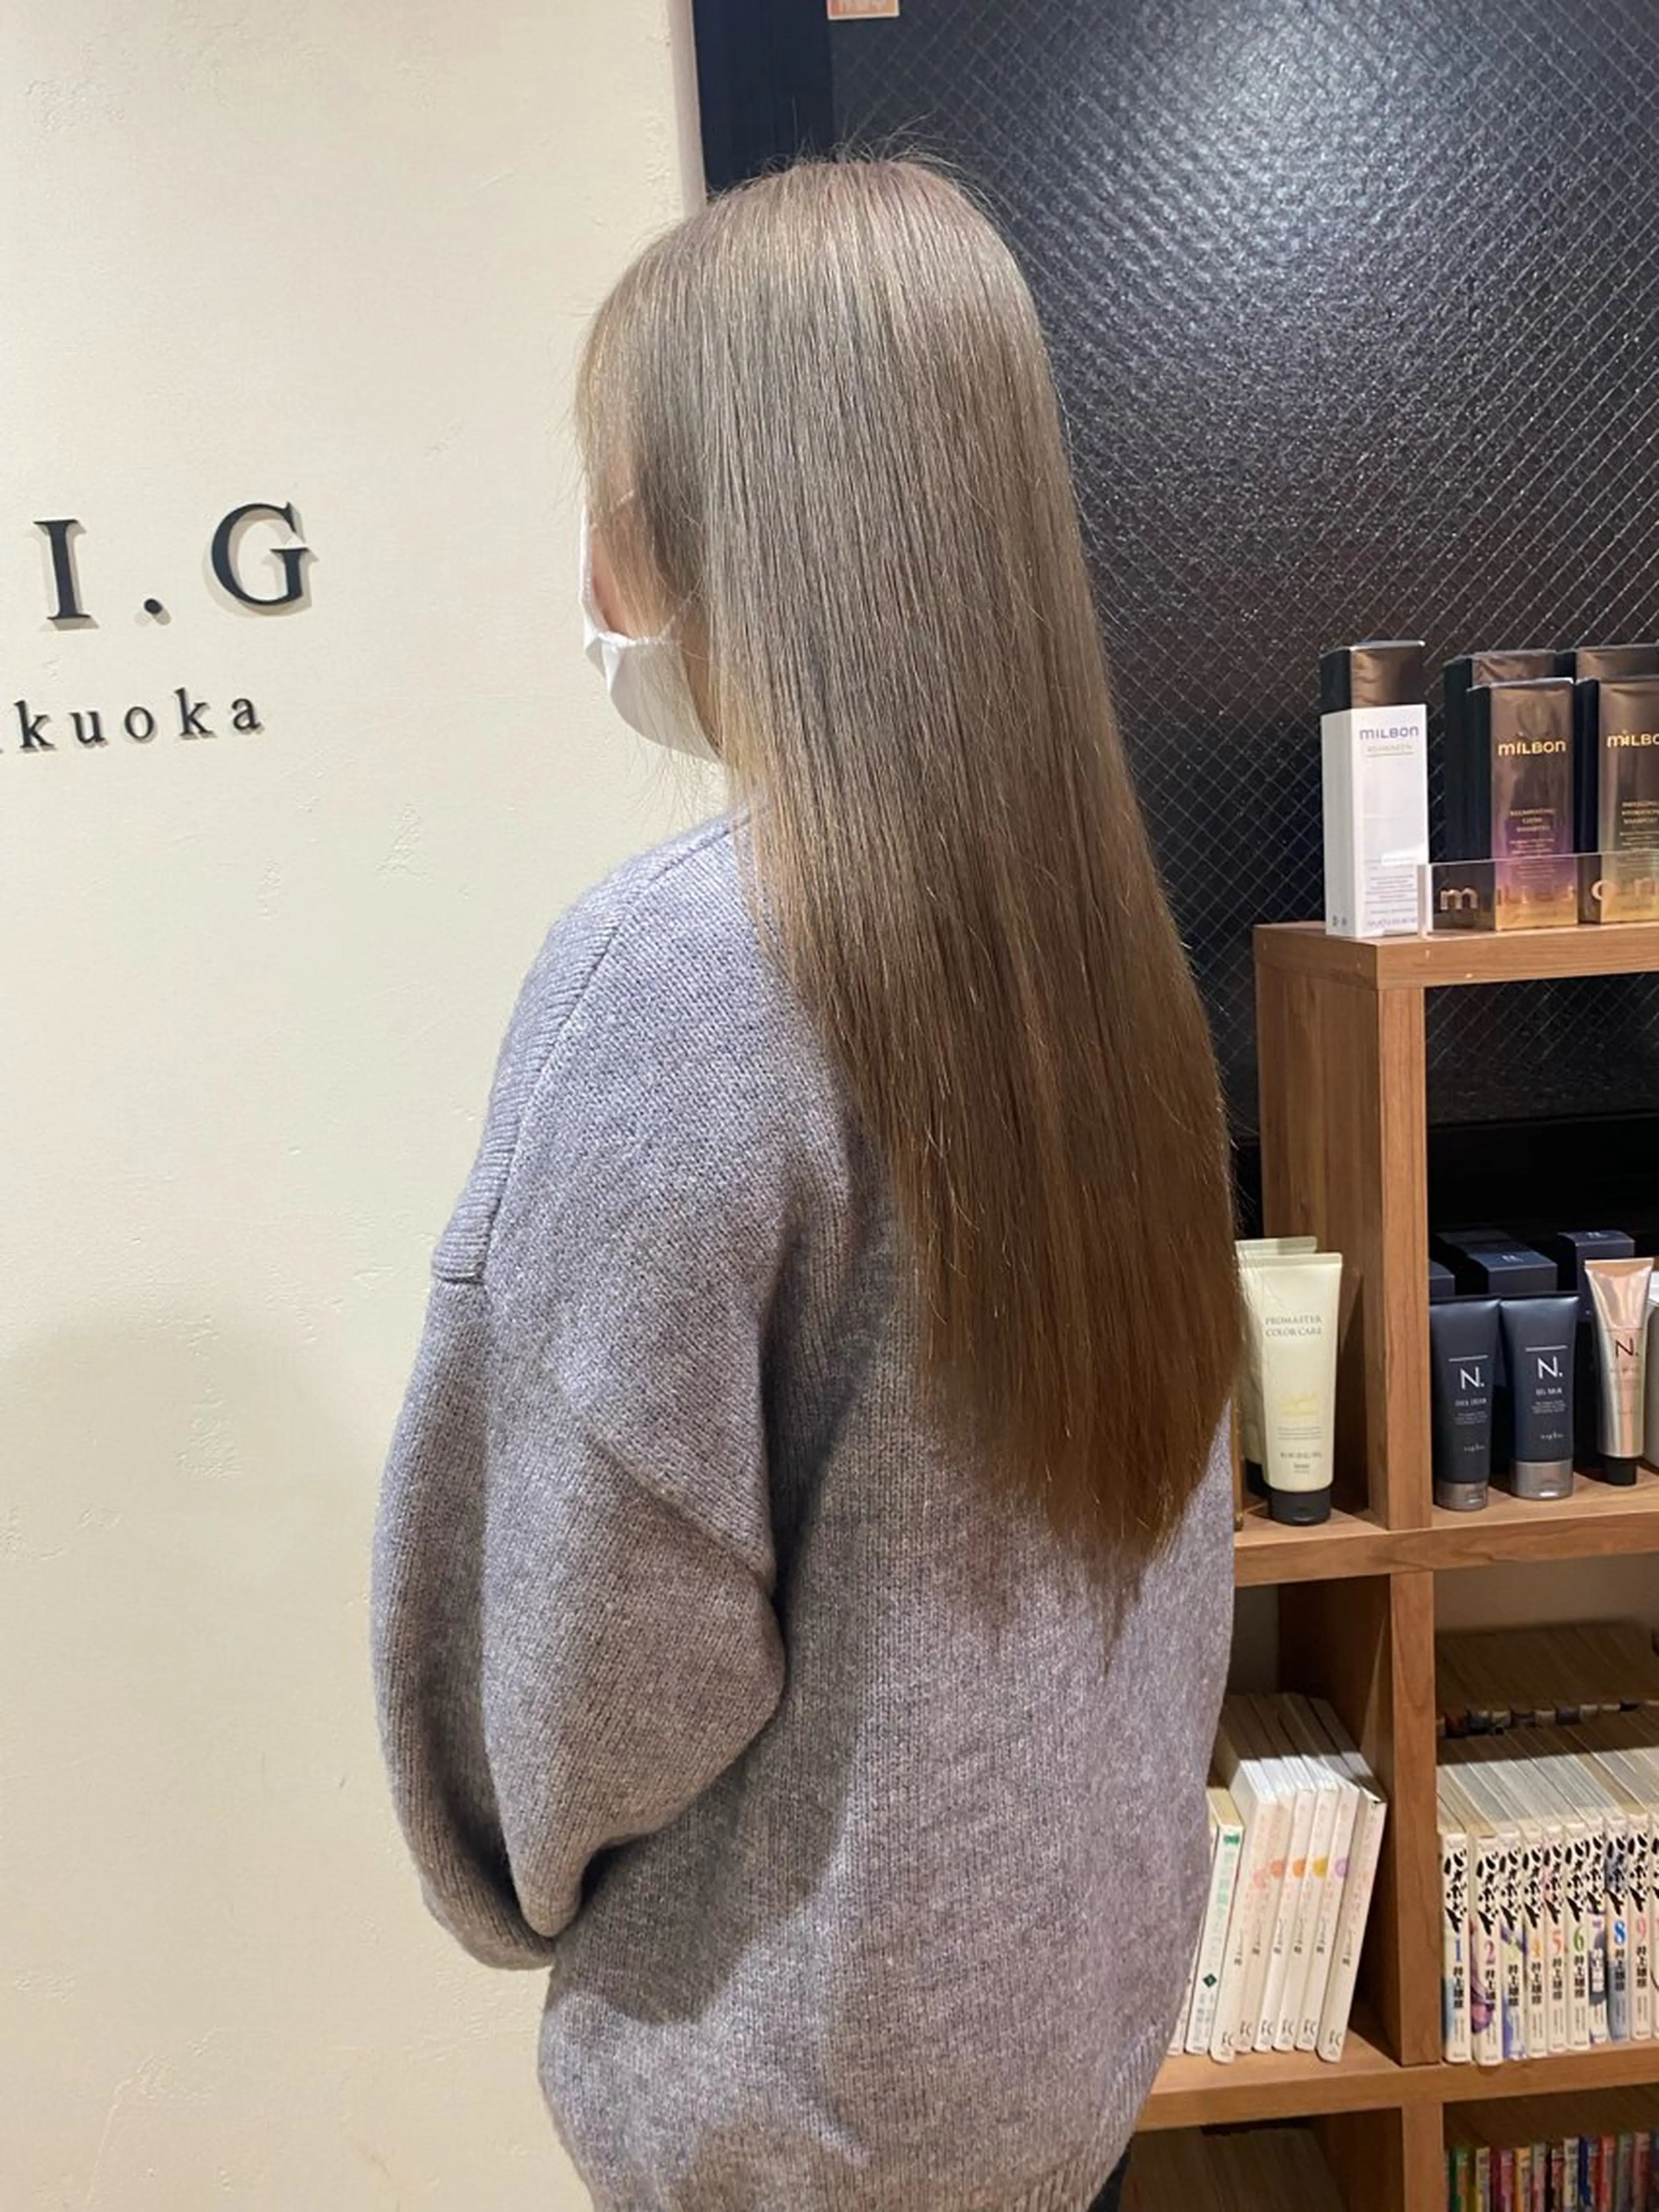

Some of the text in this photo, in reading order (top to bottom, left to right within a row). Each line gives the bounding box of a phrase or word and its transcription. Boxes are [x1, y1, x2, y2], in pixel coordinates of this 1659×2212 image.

[0, 688, 261, 748] kuoka
[1573, 1926, 1584, 1952] 6
[1614, 1920, 1625, 1946] 8
